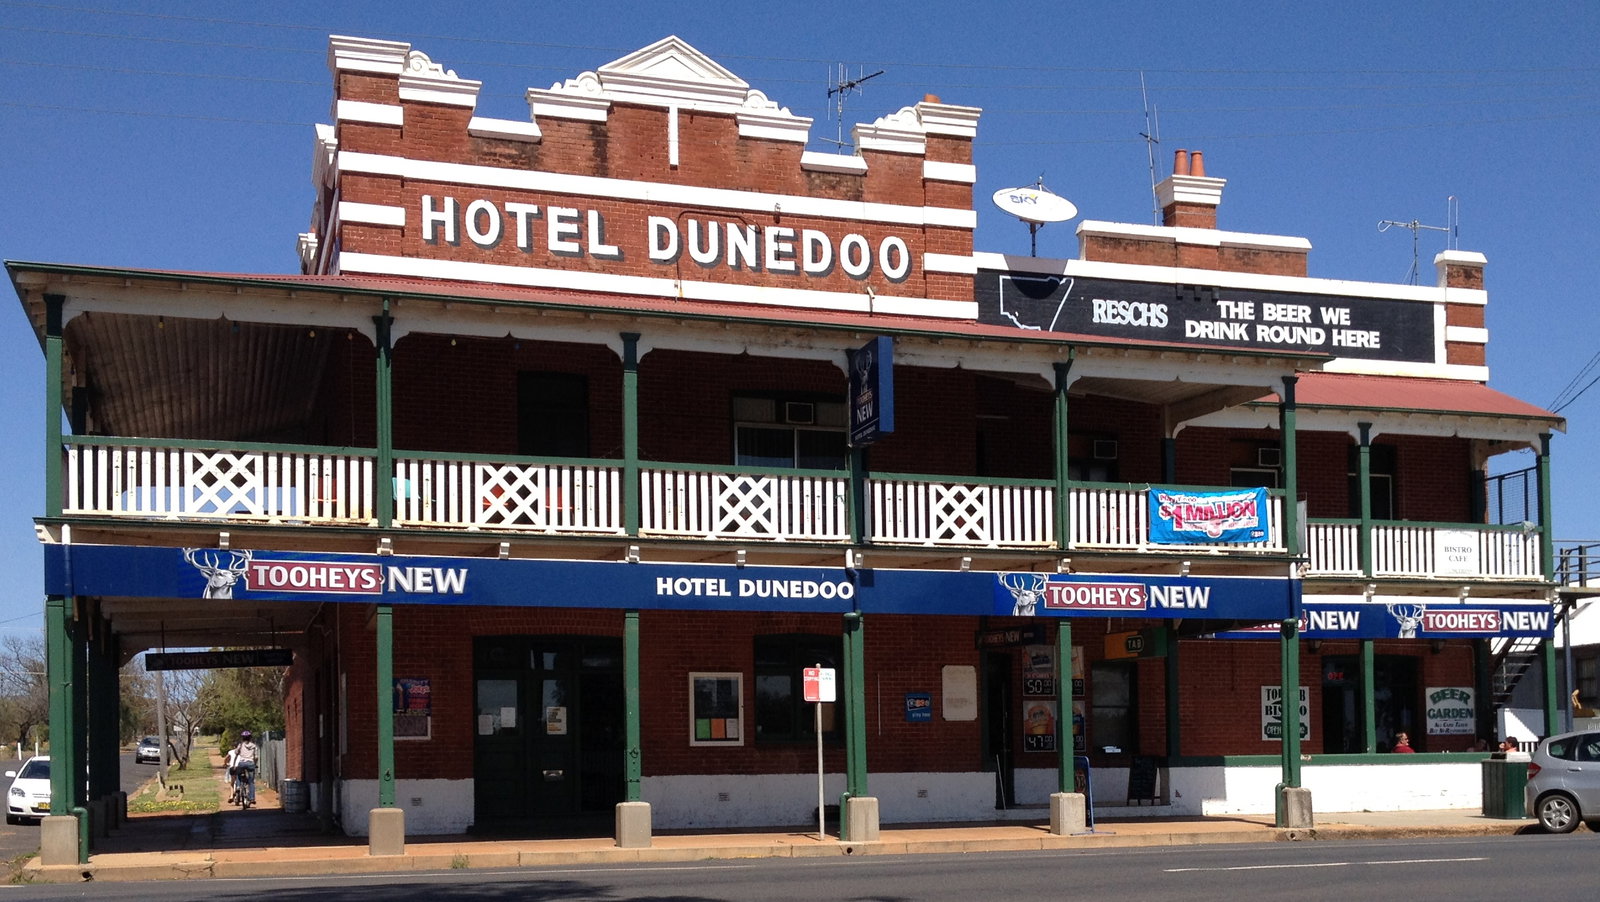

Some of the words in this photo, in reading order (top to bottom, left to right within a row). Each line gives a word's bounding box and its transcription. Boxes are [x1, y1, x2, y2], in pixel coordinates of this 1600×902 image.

[421, 195, 621, 258] HOTEL
[649, 215, 912, 282] DUNEDOO
[1092, 299, 1169, 329] RESCHS
[1217, 300, 1254, 321] THE
[1262, 304, 1311, 325] BEER
[1320, 306, 1350, 326] WE
[1185, 320, 1249, 342] DRINK
[1256, 324, 1325, 346] ROUND
[1332, 329, 1380, 349] HERE
[857, 401, 873, 425] NEW
[1185, 502, 1255, 521] MILLION
[1444, 546, 1472, 554] BISTRO
[252, 564, 376, 590] TOOHEYS
[388, 566, 468, 595] NEW
[656, 576, 732, 597] HOTEL
[739, 579, 854, 600] DUNEDOO
[1049, 586, 1142, 607] TOOHEYS
[1150, 585, 1211, 609] NEW
[1310, 611, 1360, 631] NEW
[1425, 612, 1498, 630] TOOHEYS
[1503, 611, 1550, 632] NEW
[1127, 638, 1142, 650] TAB
[1027, 679, 1043, 694] 50
[1430, 688, 1471, 706] BEER
[1428, 708, 1474, 719] GARDEN
[1028, 736, 1044, 748] 47
